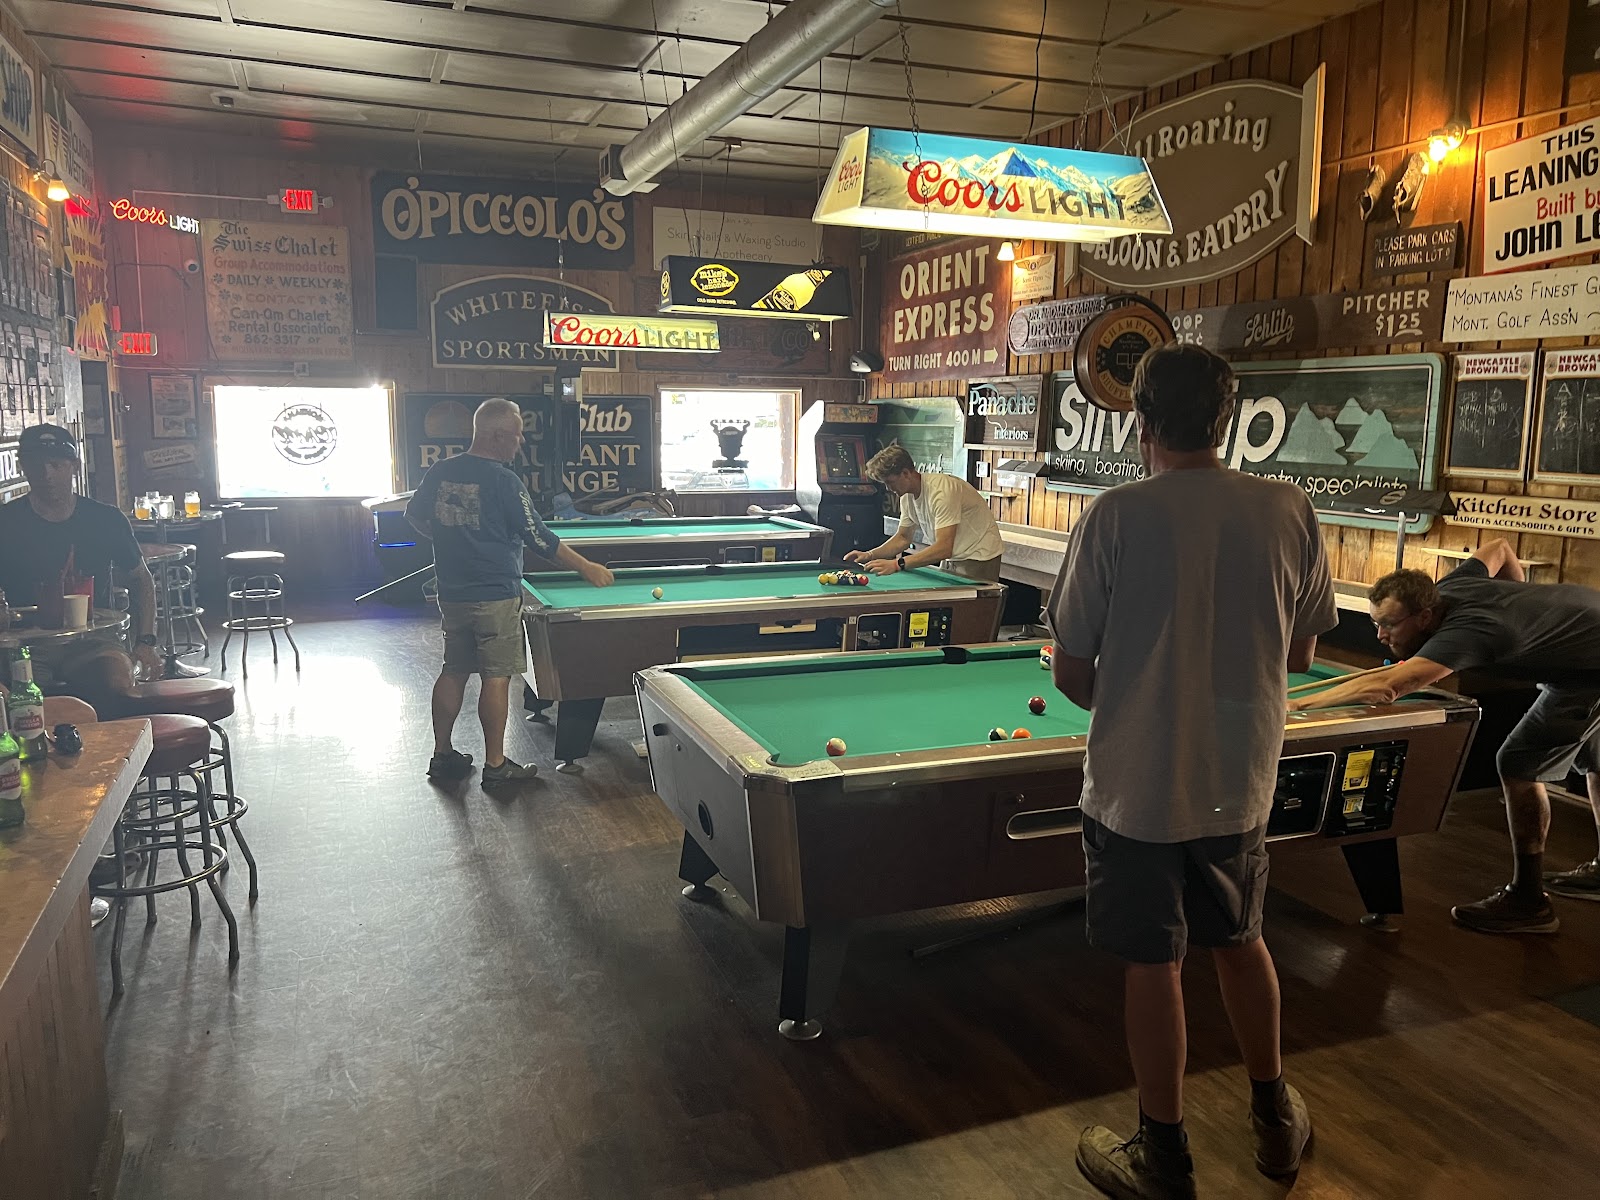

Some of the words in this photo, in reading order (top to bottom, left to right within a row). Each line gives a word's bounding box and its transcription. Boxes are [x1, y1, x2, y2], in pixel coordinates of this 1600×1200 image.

[1541, 125, 1595, 155] THIS
[839, 160, 862, 182] Coors
[1489, 146, 1599, 202] LEANING
[838, 177, 859, 193] LIGHT
[903, 160, 1024, 212] Coors
[1029, 187, 1126, 220] LIGHT
[286, 189, 313, 211] EXIT
[1537, 191, 1576, 220] Built
[110, 199, 168, 226] Coors
[170, 215, 199, 234] LIGHT
[382, 177, 626, 250] O'PICCOLO'S
[1167, 243, 1180, 268] &
[1186, 160, 1288, 263] EATERY
[221, 222, 249, 235] The
[697, 229, 720, 242] Nails
[725, 234, 731, 242] &
[734, 233, 772, 249] Waxing
[774, 235, 806, 248] Studio
[213, 234, 271, 253] Swiss
[275, 235, 338, 256] Chalet
[1374, 236, 1405, 253] PLEASE
[1408, 232, 1427, 247] PARK
[1432, 228, 1457, 243] CARS
[214, 256, 247, 272] Group
[250, 258, 346, 275] Accommodations
[717, 251, 773, 263] Apothecary
[1375, 257, 1384, 268] IN
[1389, 250, 1422, 267] PARKING
[227, 274, 261, 287] DAILY
[279, 276, 331, 289] WEEKLY
[900, 245, 990, 300] ORIENT
[246, 293, 316, 305] CONTACT
[1531, 281, 1578, 301] FINEST
[1342, 289, 1430, 315] PITCHER
[289, 308, 331, 323] Chalet
[894, 292, 994, 344] EXPRESS
[1452, 315, 1489, 332] MONT.
[1497, 311, 1532, 329] GOLF
[229, 320, 269, 333] Rental
[551, 316, 641, 347] Coors
[644, 329, 717, 350] LIGHT
[123, 333, 150, 353] EXIT
[244, 333, 300, 345] 862-3317
[889, 356, 910, 371] TURN
[914, 352, 942, 368] RIGHT
[946, 350, 969, 367] 400
[972, 348, 981, 365] M
[1465, 366, 1499, 374] BROWN
[1501, 365, 1519, 374] ALE
[1558, 363, 1597, 372] BROWN
[1466, 357, 1519, 367] NEWCASTLE
[1559, 354, 1600, 364] NEWCAS
[968, 384, 1036, 417] Panache
[994, 426, 1029, 441] Interiors
[1054, 456, 1087, 477] skiing,
[1456, 496, 1533, 518] Kitchen
[1539, 503, 1598, 523] Store
[1453, 515, 1491, 525] GADGETS
[1493, 519, 1555, 532] ACCESSORIES
[1566, 525, 1595, 535] GIFTS
